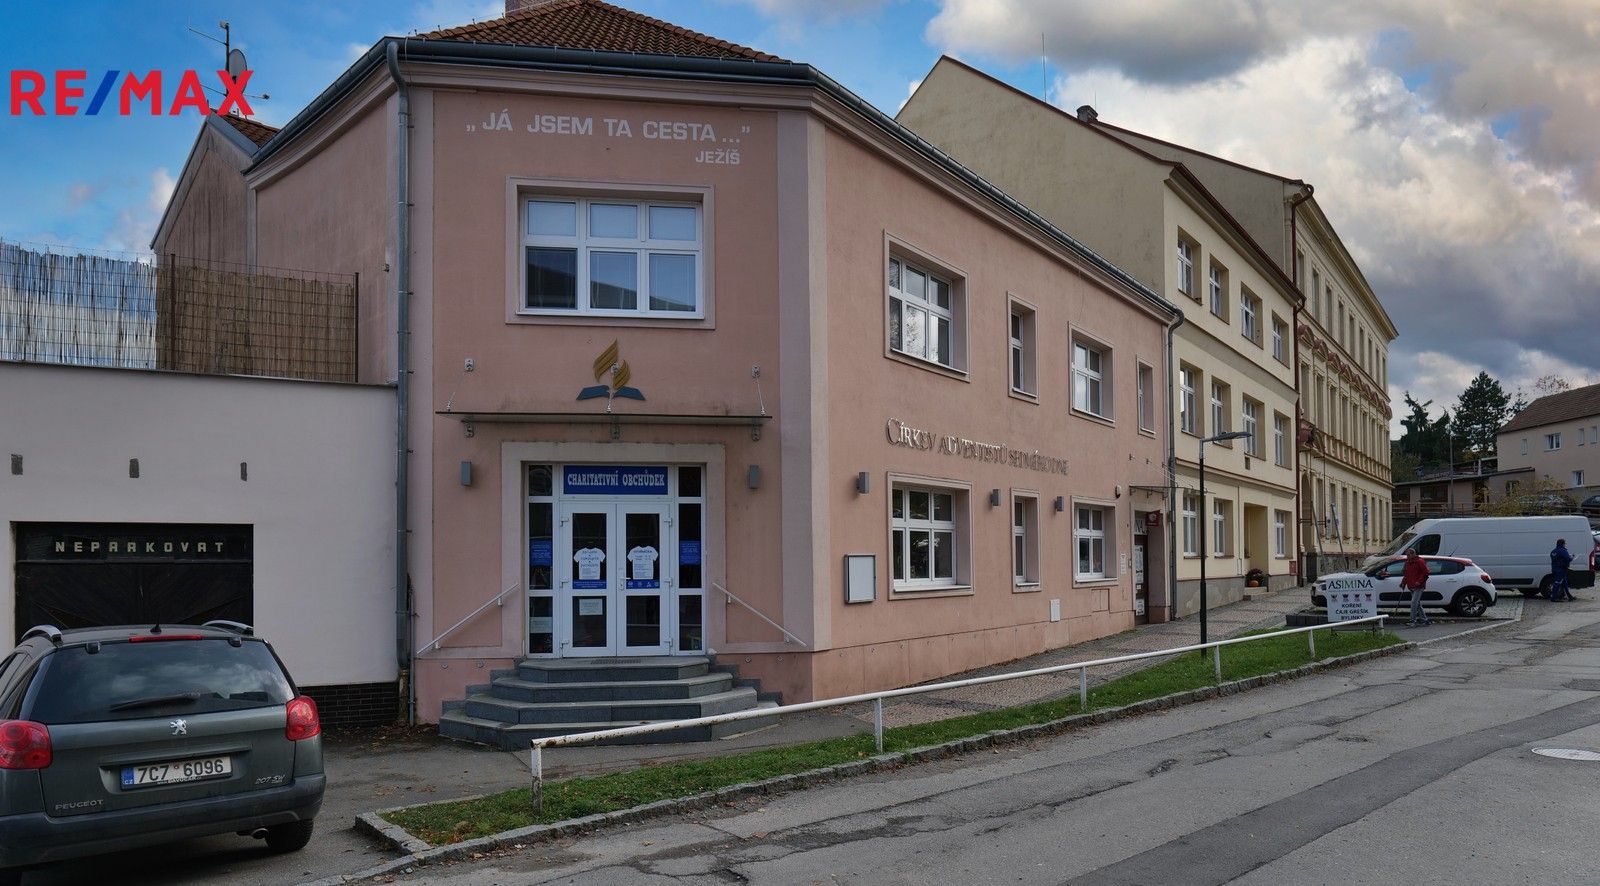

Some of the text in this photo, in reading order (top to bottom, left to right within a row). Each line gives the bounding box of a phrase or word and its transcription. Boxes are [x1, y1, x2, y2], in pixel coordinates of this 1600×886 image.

[527, 114, 593, 136] JSEM
[603, 118, 633, 138] TA
[695, 148, 740, 165] JEŽÍŠ
[567, 470, 665, 486] CHARITATIVNÍ OBCHŮDEK
[55, 541, 224, 552] NEPARKOVAT
[1328, 579, 1373, 589] ASIMINA
[138, 765, 170, 783] 7C7
[183, 759, 225, 777] 6096
[55, 800, 104, 810] PEUGEOT
